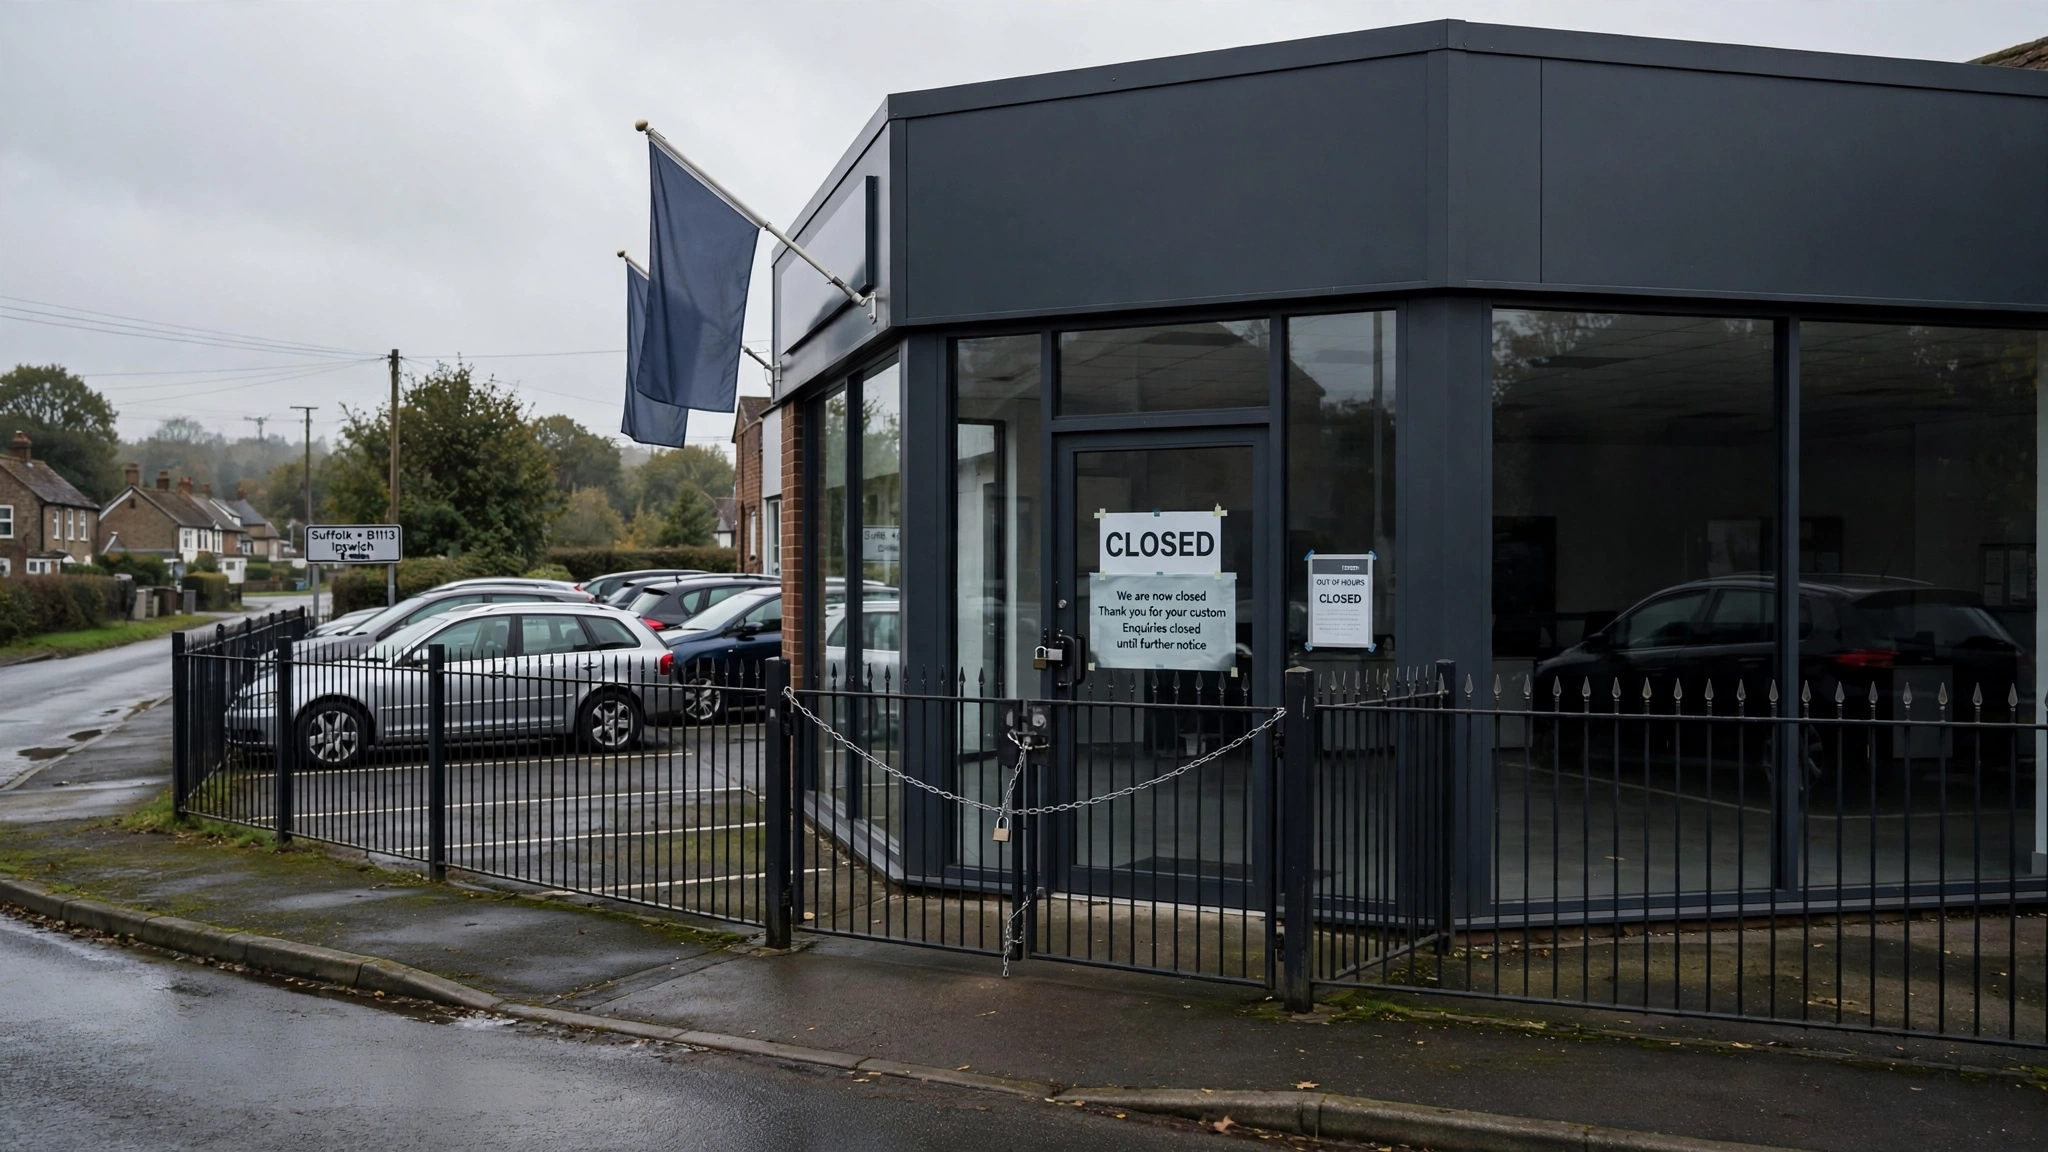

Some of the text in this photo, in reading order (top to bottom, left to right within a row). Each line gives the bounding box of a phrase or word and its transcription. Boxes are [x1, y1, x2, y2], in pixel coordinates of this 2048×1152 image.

[311, 530, 395, 540] Suffolk B1113
[1105, 531, 1215, 557] CLOSED
[1316, 578, 1330, 586] OUT
[1341, 578, 1365, 586] HOURS
[1116, 590, 1207, 602] We are now closed
[1319, 593, 1362, 604] CLOSED
[1098, 605, 1227, 620] Thank you for your custom
[1122, 622, 1201, 636] Enquiries closed
[1116, 638, 1207, 651] until further notice
